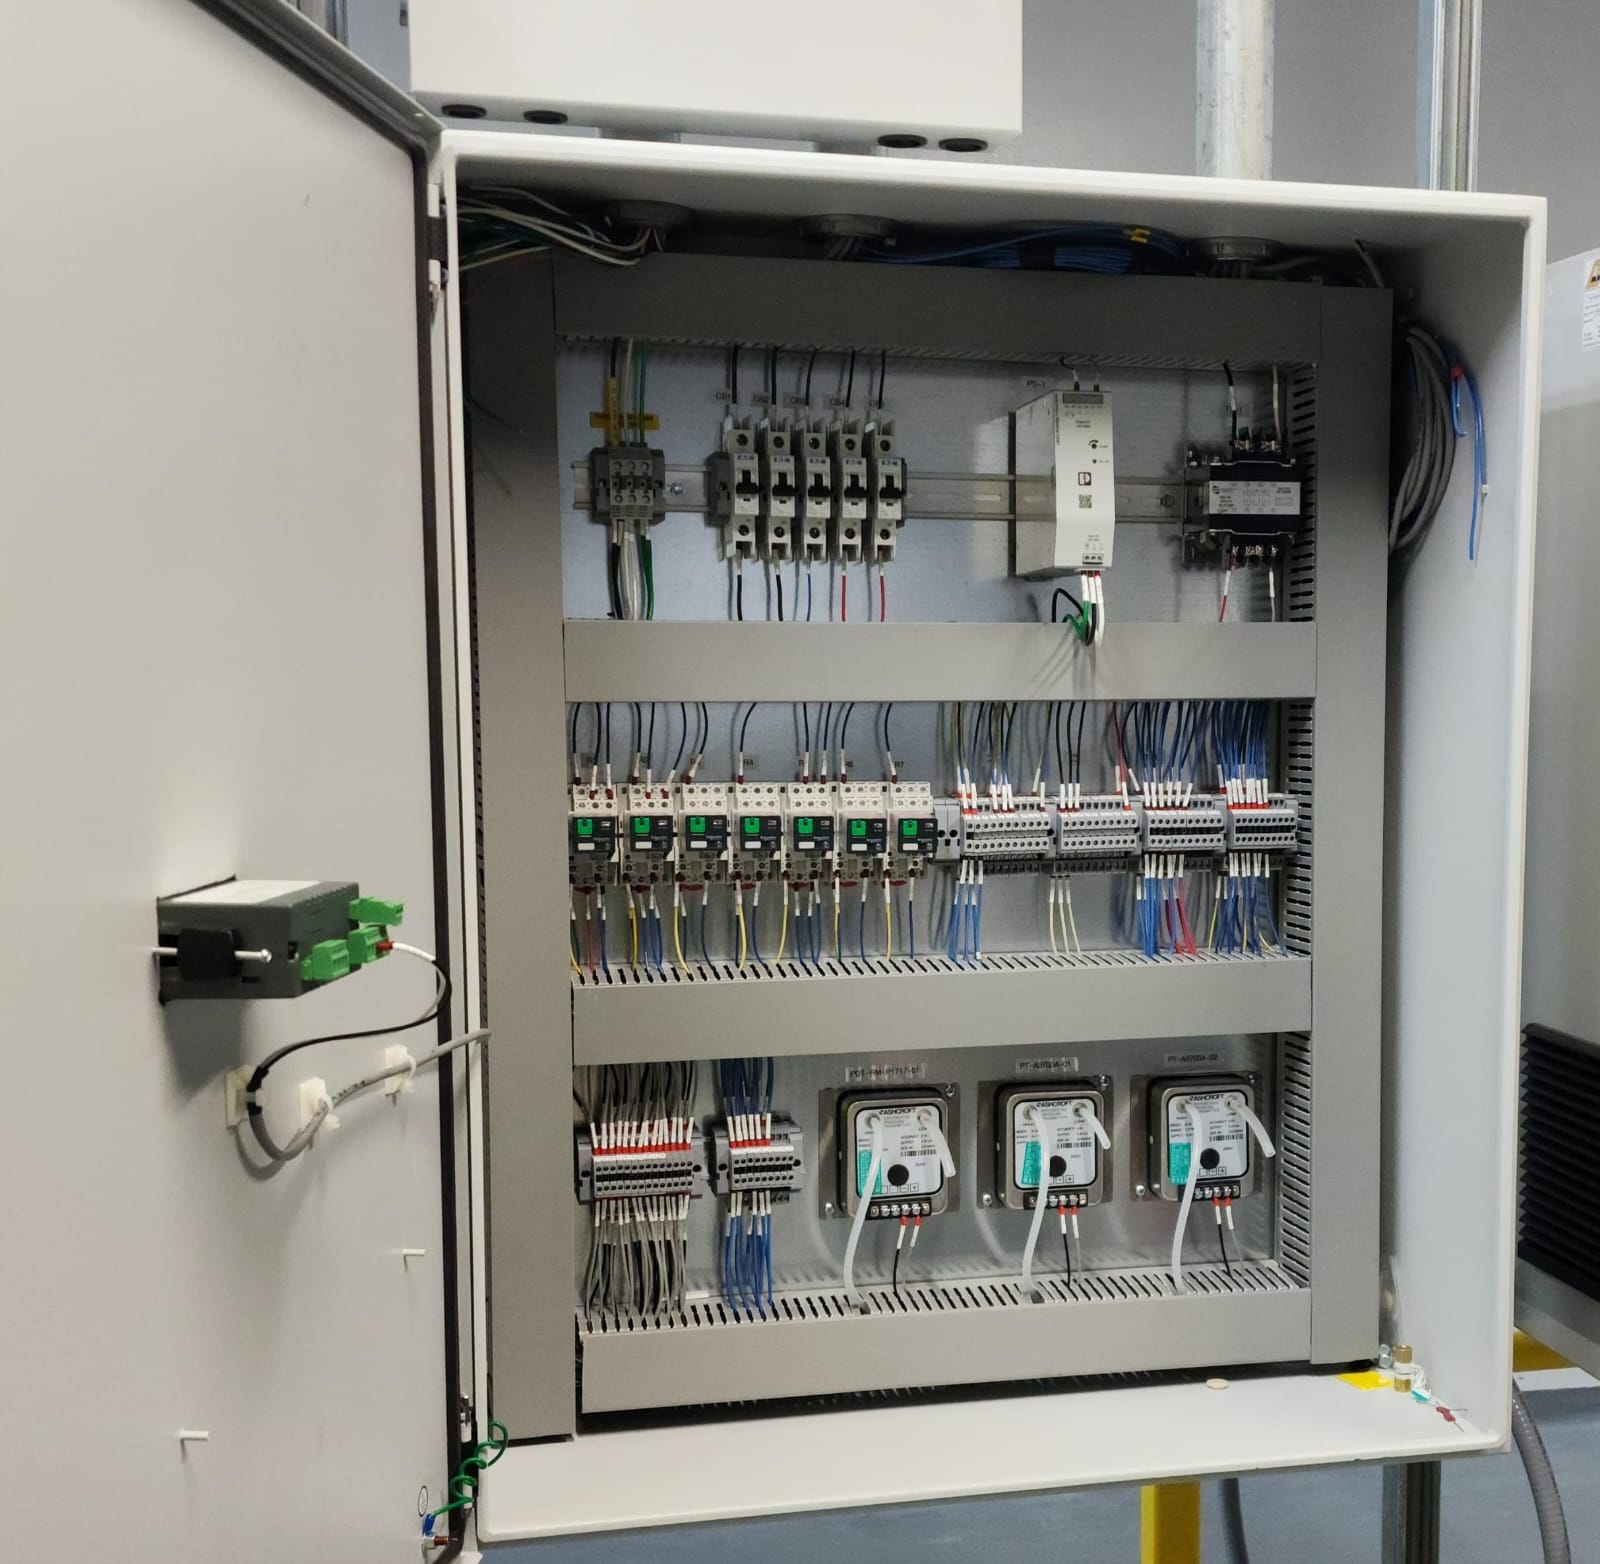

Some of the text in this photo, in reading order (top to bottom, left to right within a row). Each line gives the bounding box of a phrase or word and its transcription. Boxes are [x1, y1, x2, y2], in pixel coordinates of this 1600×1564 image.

[1193, 1093, 1224, 1101] ASHCROFT
[1040, 1100, 1072, 1108] ASHCROFT
[883, 1107, 916, 1115] ASHCROFT
